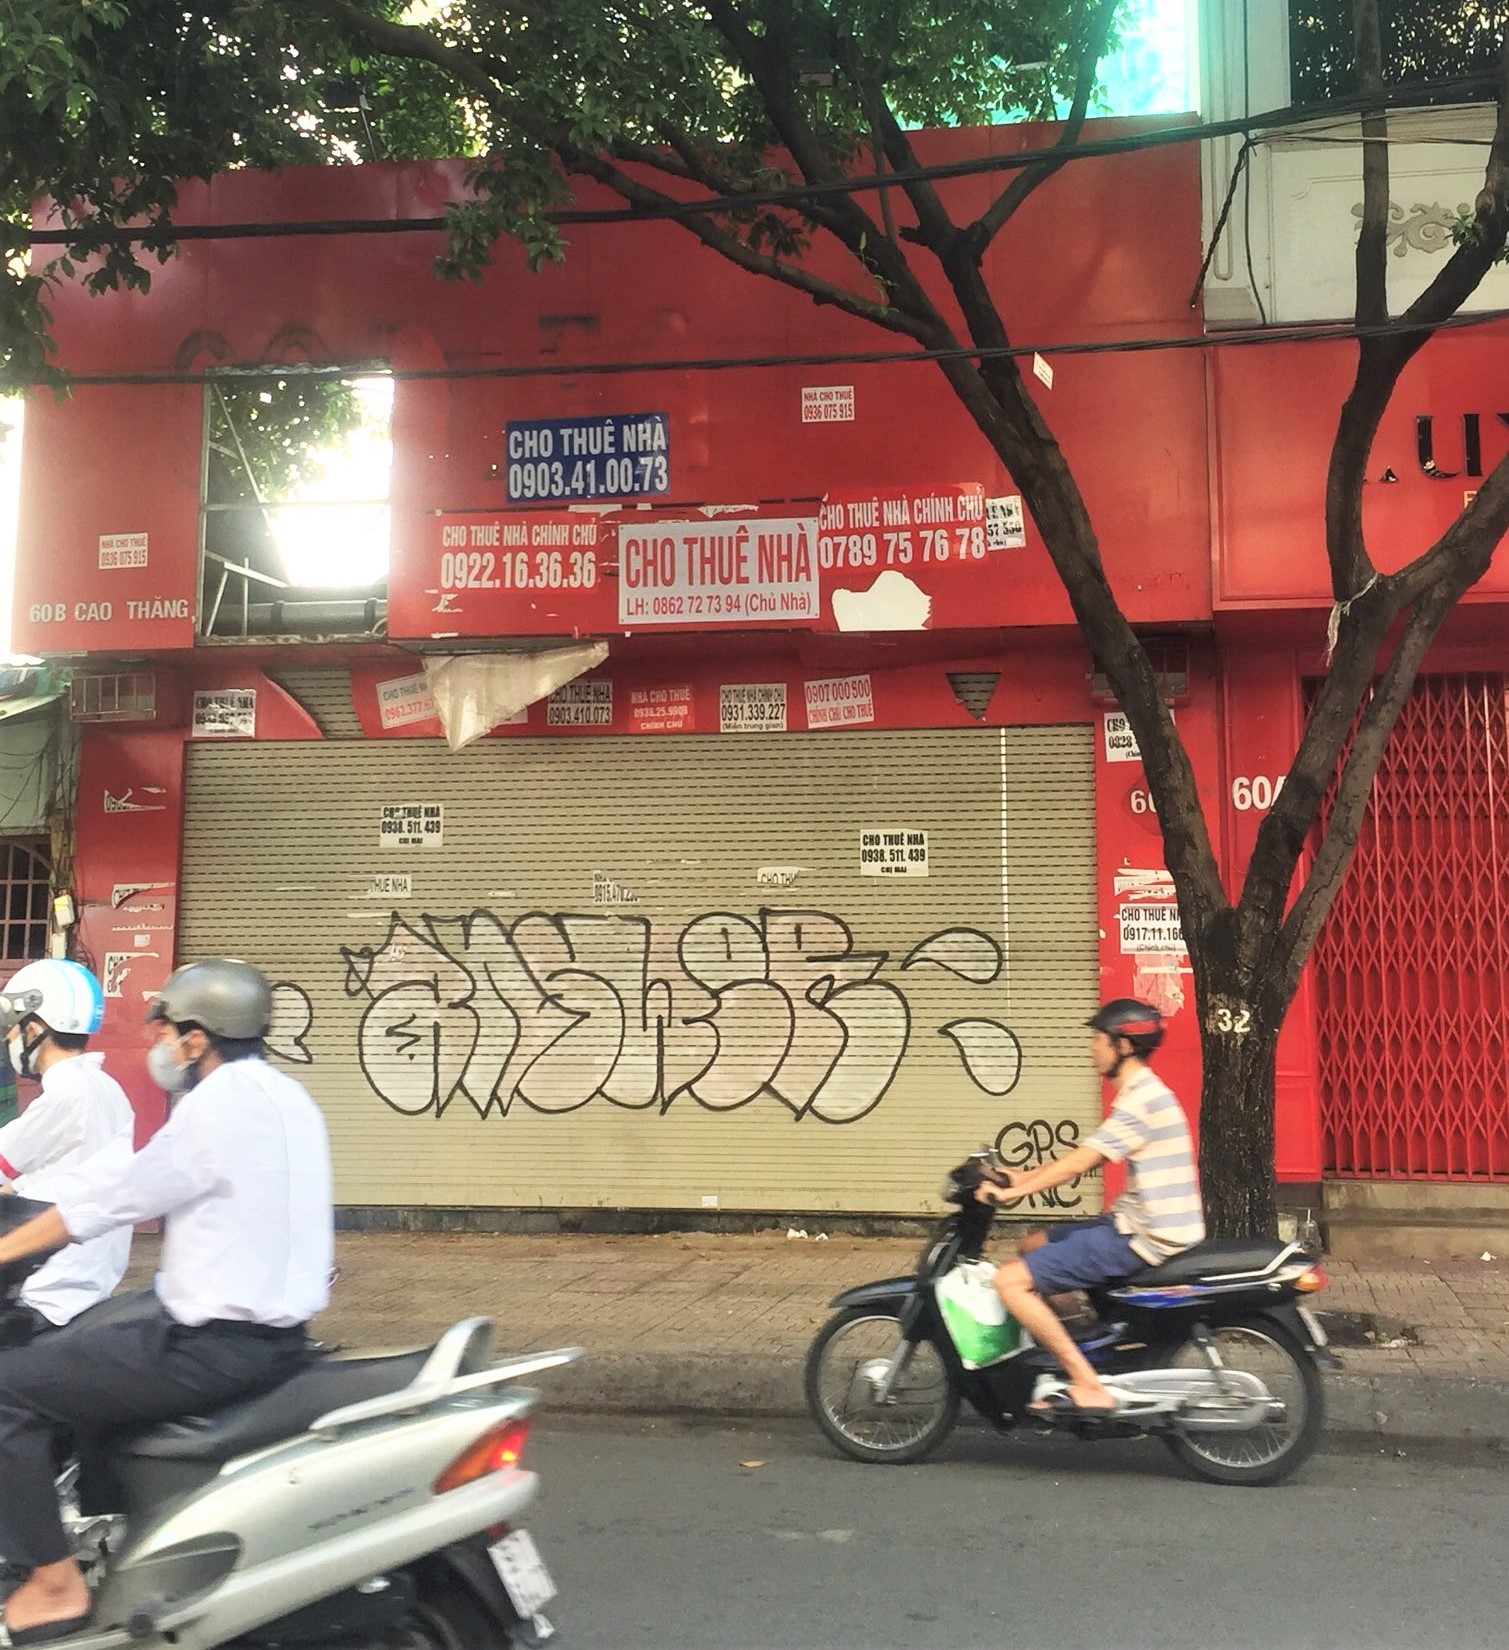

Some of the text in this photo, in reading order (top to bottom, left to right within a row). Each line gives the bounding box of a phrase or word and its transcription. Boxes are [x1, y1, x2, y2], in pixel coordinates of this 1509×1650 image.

[819, 390, 834, 401] CHO
[804, 402, 853, 420] 0936 075 915
[509, 416, 667, 459] CHO THUÊ NHÀ
[509, 455, 668, 498] 0903.41.00.73
[819, 502, 843, 531] CHO
[847, 496, 880, 529] THUÊ
[882, 494, 911, 527] NHÀ
[914, 493, 953, 524] CHÍNH
[957, 484, 984, 522] CHỦ
[443, 517, 598, 547] CHO THUÊ NHÀ CHÍNH CHỦ
[625, 523, 812, 588] CHO THUÊ NHÀ
[819, 526, 986, 569] 0789 75 76 78
[441, 551, 596, 589] 0922.16.36.36
[74, 602, 113, 621] CAO
[626, 591, 811, 616] LH: 0862 72 73 94 (Chủ Nhà)
[806, 679, 870, 704] 0907 000 500
[550, 706, 611, 724] 0903.410.073
[721, 703, 786, 721] 0931.339.227
[1131, 790, 1158, 814] 6
[424, 820, 442, 834] 439
[862, 833, 881, 847] CHO
[883, 831, 905, 846] THUÊ
[861, 848, 926, 863] 0938. 511. 439
[1121, 908, 1141, 922] CHO
[1143, 906, 1167, 921] THUÊ
[1217, 1008, 1251, 1034] 32
